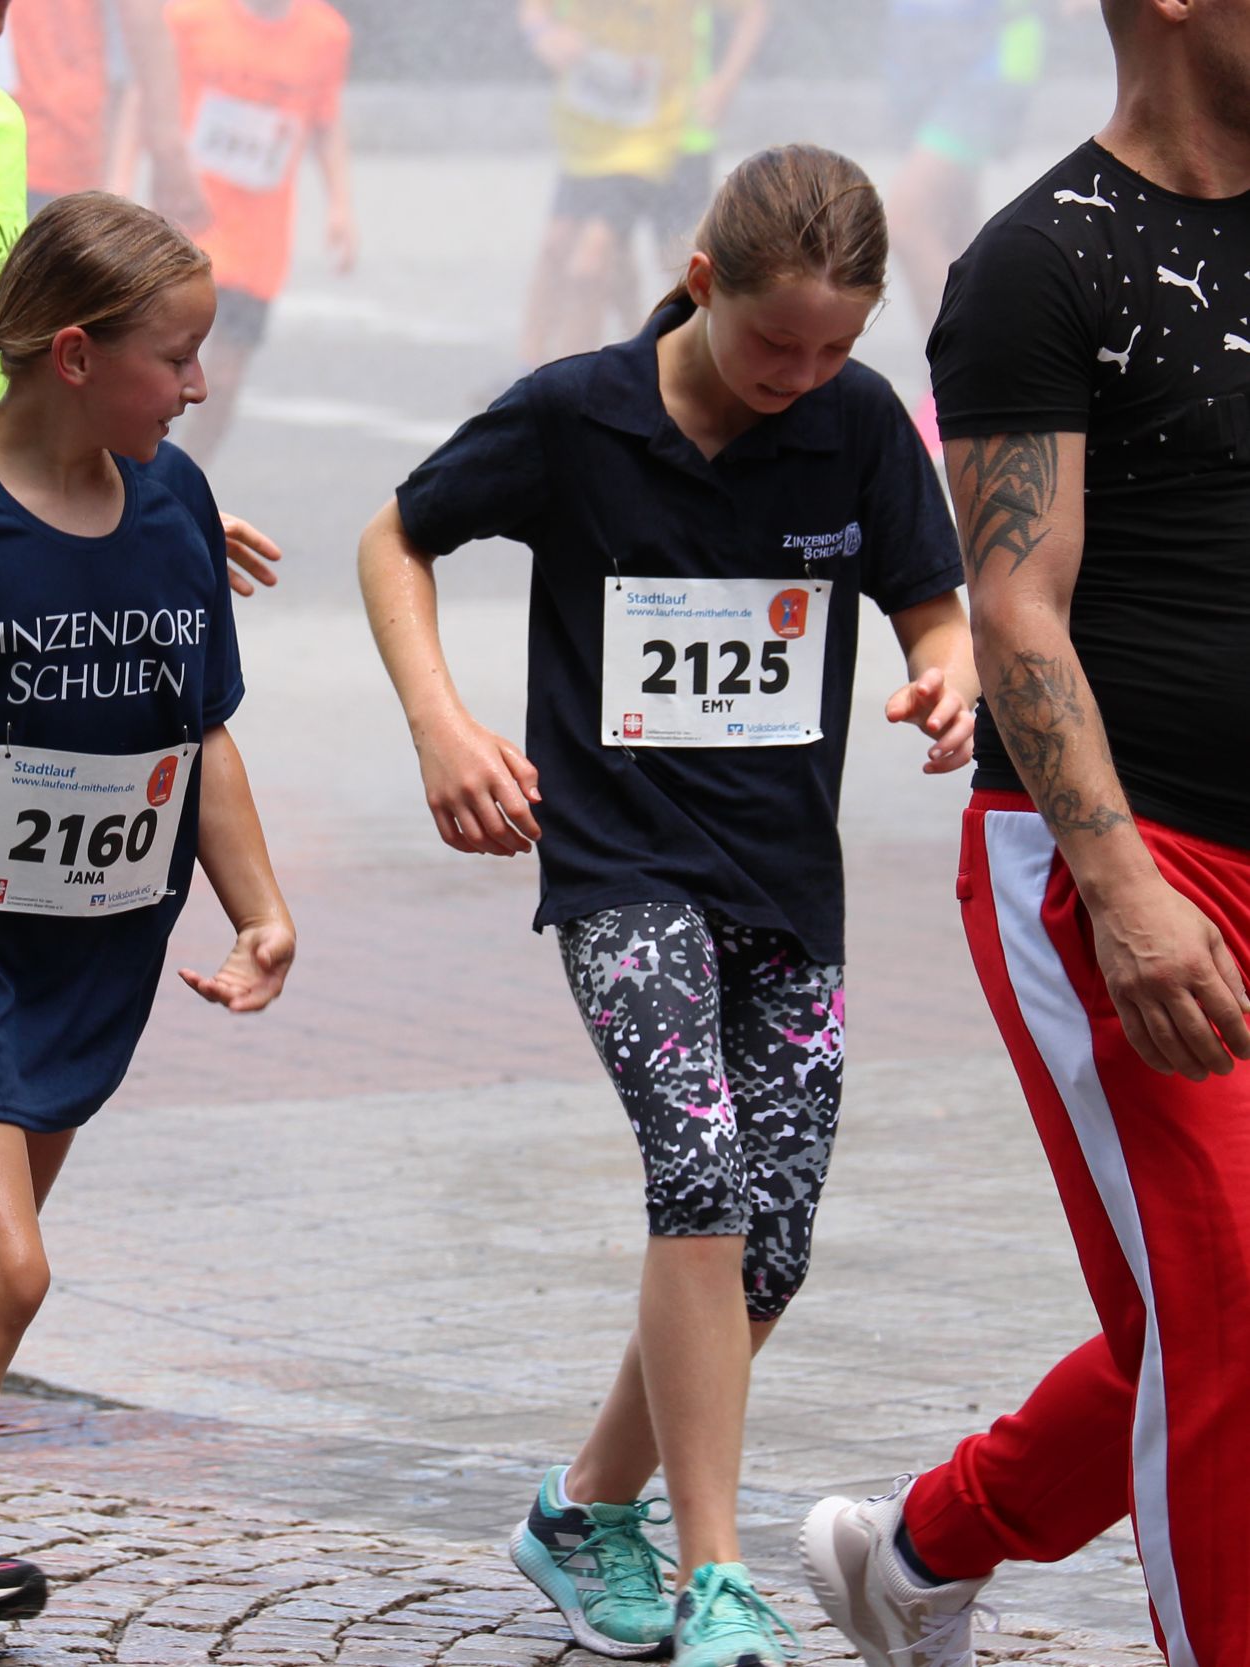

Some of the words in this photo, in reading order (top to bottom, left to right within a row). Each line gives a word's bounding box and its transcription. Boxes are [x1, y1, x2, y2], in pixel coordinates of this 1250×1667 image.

[626, 592, 687, 606] Stadtlauf
[626, 606, 752, 619] www.laufend-mithelfen.de
[641, 639, 790, 695] 2125
[7, 659, 185, 704] SCHULEN
[701, 699, 735, 713] EMY
[13, 760, 77, 779] Stadtlauf
[11, 775, 135, 793] www.laufend-mithelfen.de
[8, 808, 158, 868] 2160
[64, 870, 105, 885] JANA
